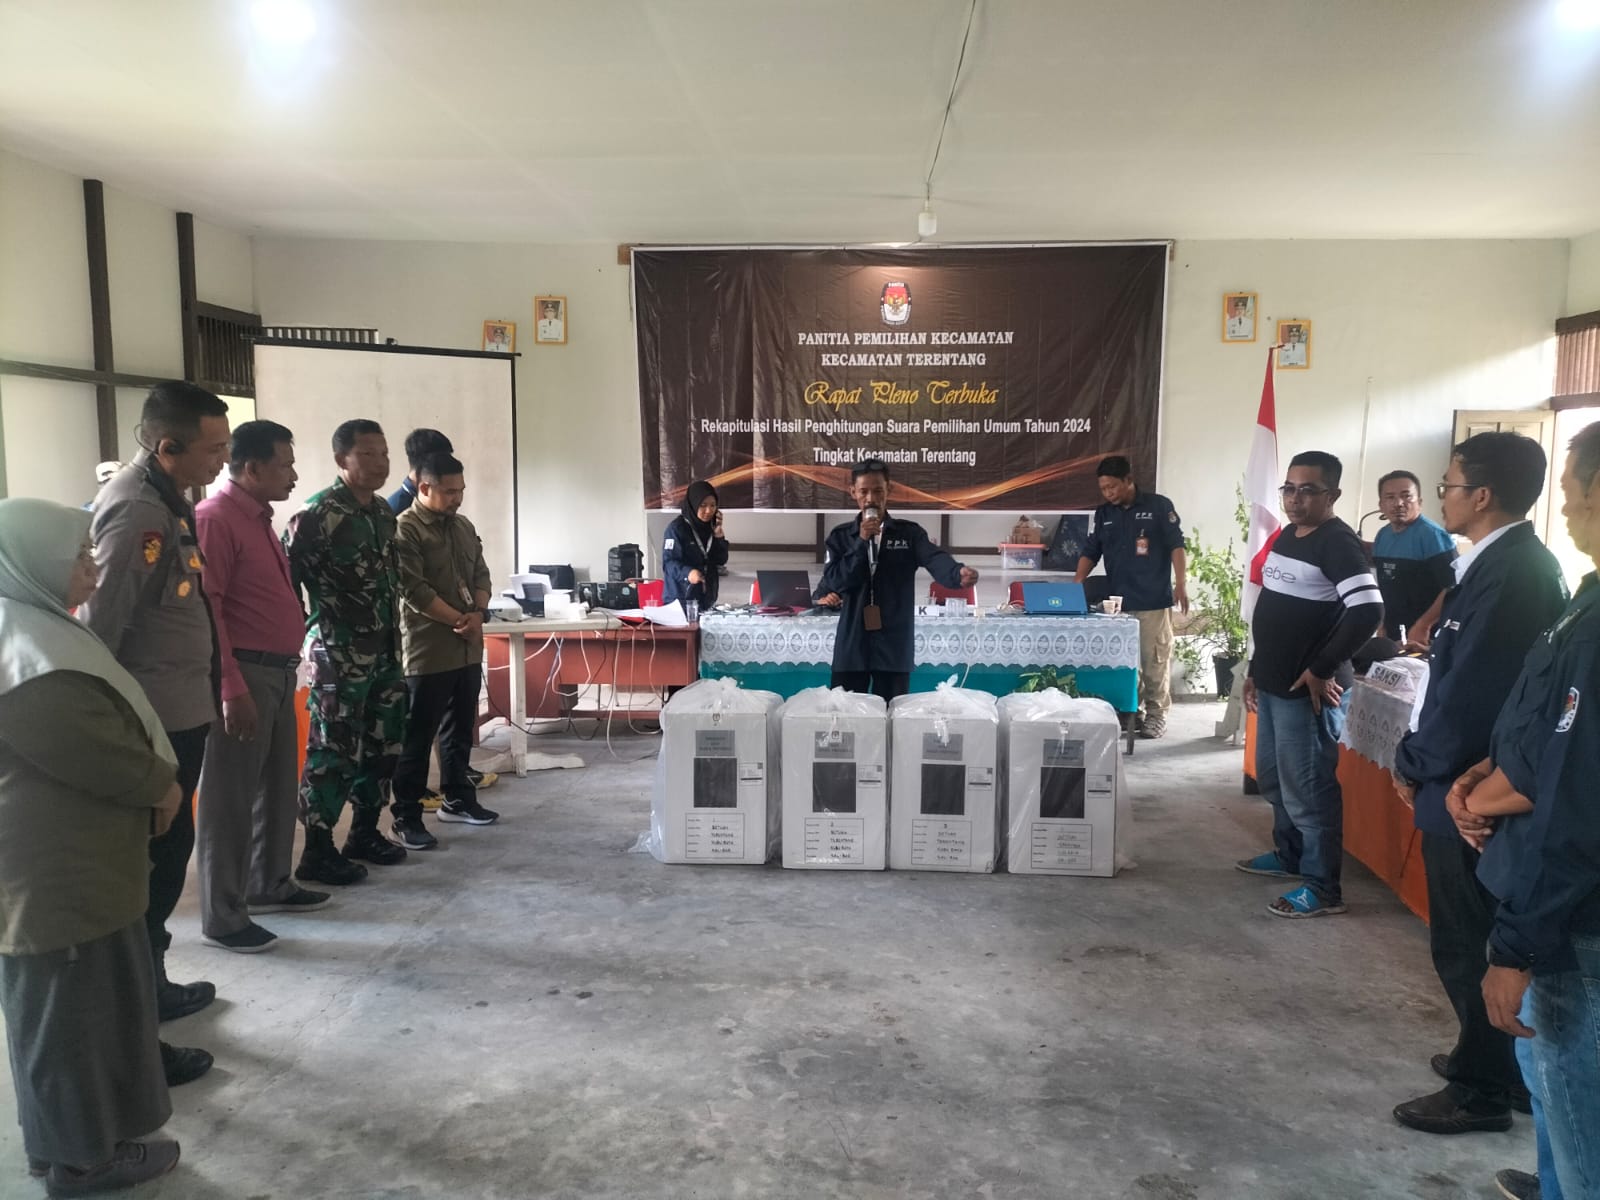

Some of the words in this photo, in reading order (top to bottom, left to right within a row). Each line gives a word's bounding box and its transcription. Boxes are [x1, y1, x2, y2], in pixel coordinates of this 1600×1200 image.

[798, 332, 850, 345] PANITIA
[854, 332, 927, 345] PEMILIHAN
[930, 331, 1014, 345] KECAMATAN
[821, 353, 902, 366] KECAMATAN
[906, 352, 986, 366] TERENTANG
[804, 380, 862, 412] Rapat
[870, 379, 919, 405] Pleno
[927, 380, 999, 405] Terbuka
[701, 418, 769, 436] Rekapitulasi
[773, 418, 800, 433] Hasil
[805, 418, 883, 437] Penghitungan
[886, 418, 920, 433] Suara
[923, 418, 980, 433] Pemilihan
[984, 418, 1020, 433] Umum
[1024, 418, 1060, 433] Tahun
[1062, 417, 1091, 433] 2024
[813, 447, 854, 466] Tingkat
[857, 447, 918, 463] Kecamatan
[921, 447, 976, 467] Terentang
[1372, 666, 1402, 688] SAKSI
